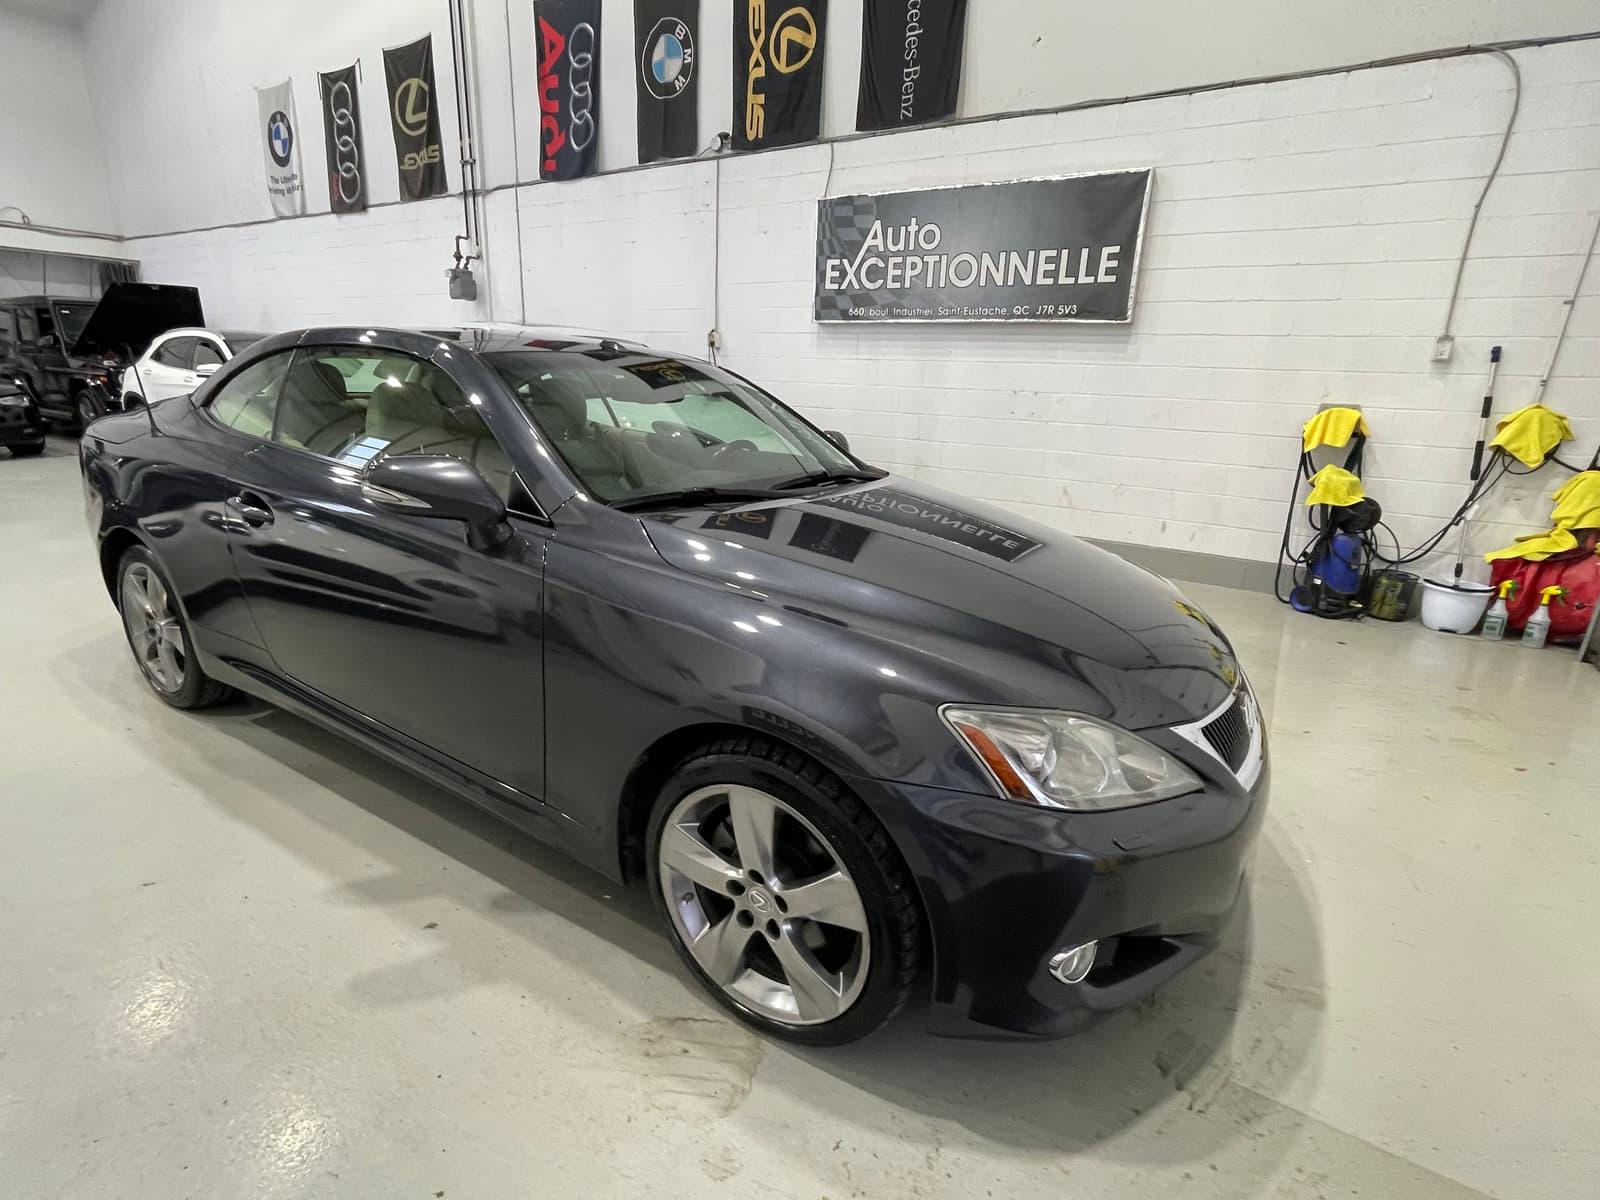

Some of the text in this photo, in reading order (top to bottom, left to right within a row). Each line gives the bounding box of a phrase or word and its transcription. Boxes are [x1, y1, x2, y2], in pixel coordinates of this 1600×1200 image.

[857, 217, 941, 254] Auto
[824, 245, 1121, 290] EXCEPTIONNELLE
[938, 306, 1009, 317] Saint-Eustache,
[1012, 305, 1031, 315] QC
[1035, 304, 1055, 315] J7R
[1057, 304, 1077, 315] 5V3
